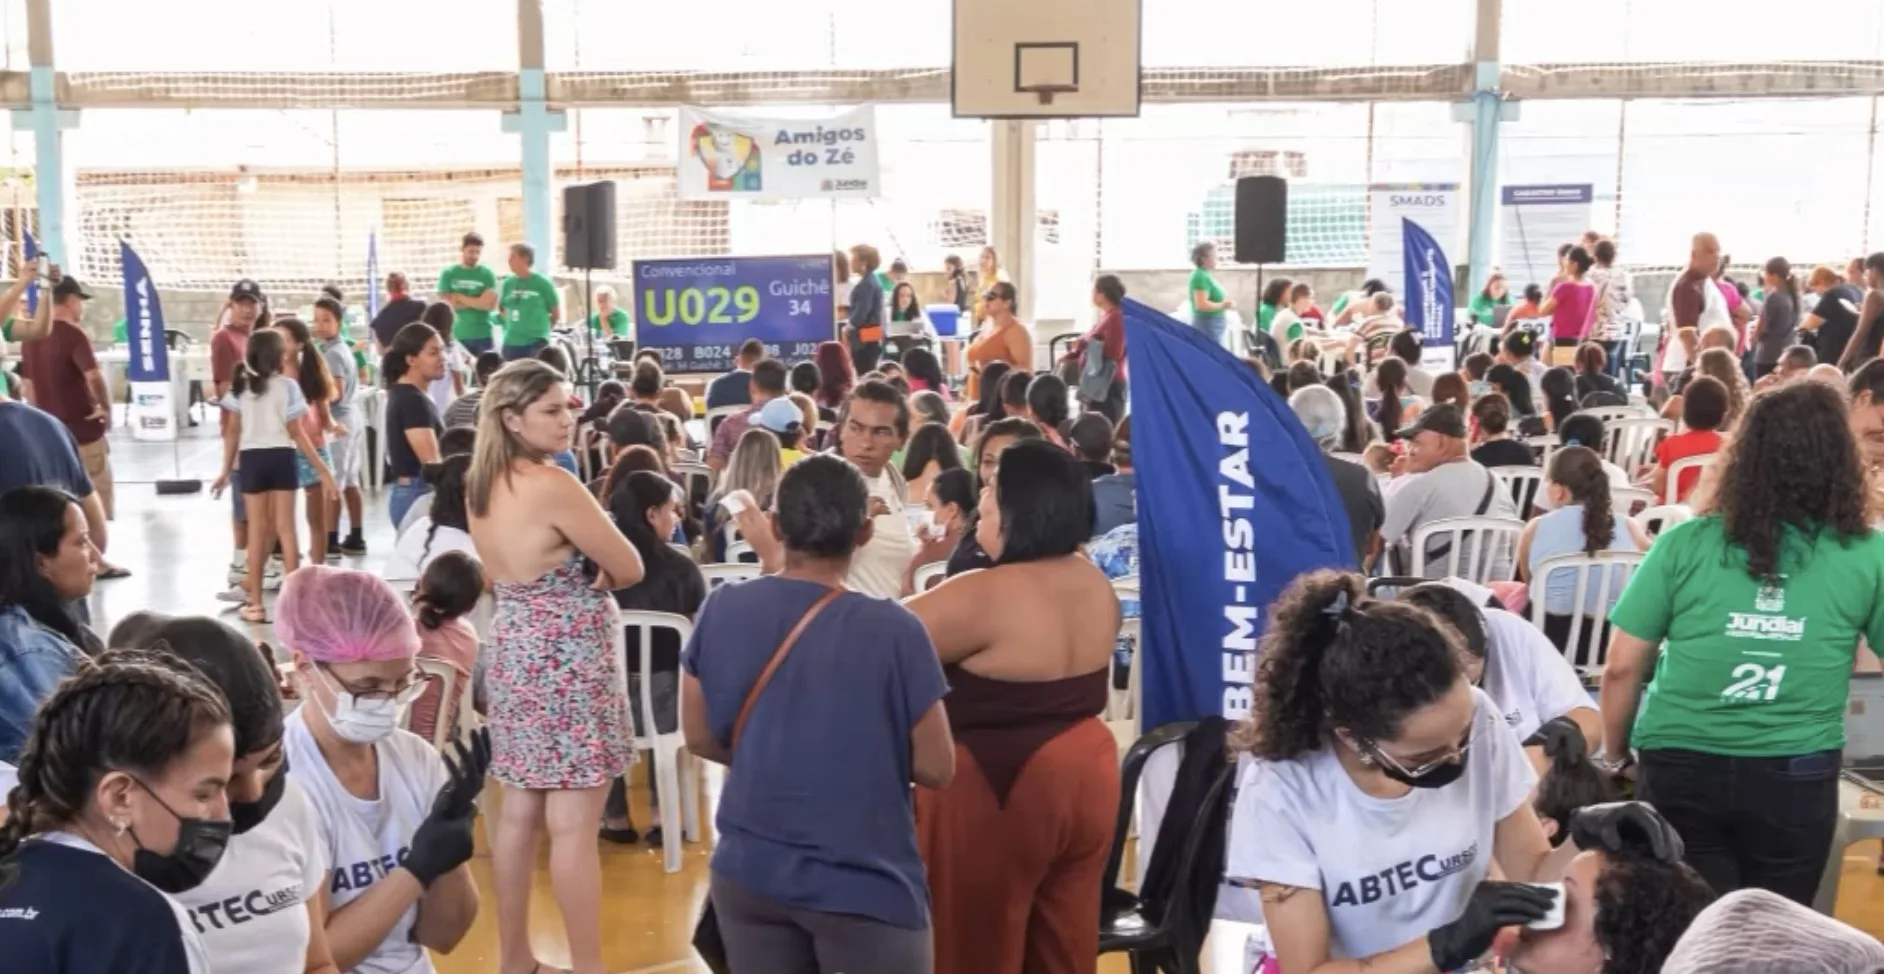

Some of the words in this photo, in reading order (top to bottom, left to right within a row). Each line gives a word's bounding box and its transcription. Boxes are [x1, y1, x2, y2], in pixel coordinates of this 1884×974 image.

[774, 126, 866, 147] Amigos
[787, 150, 818, 167] do
[825, 146, 856, 166] Zé
[1389, 194, 1446, 207] SMADS
[640, 261, 736, 279] Convencional
[768, 277, 831, 298] Guichê
[643, 285, 761, 327] U029
[787, 299, 812, 317] 34
[135, 275, 156, 372] SENHA
[693, 344, 732, 360] B024
[1216, 410, 1259, 721] BEM-ESTAR
[1720, 662, 1788, 701] 21
